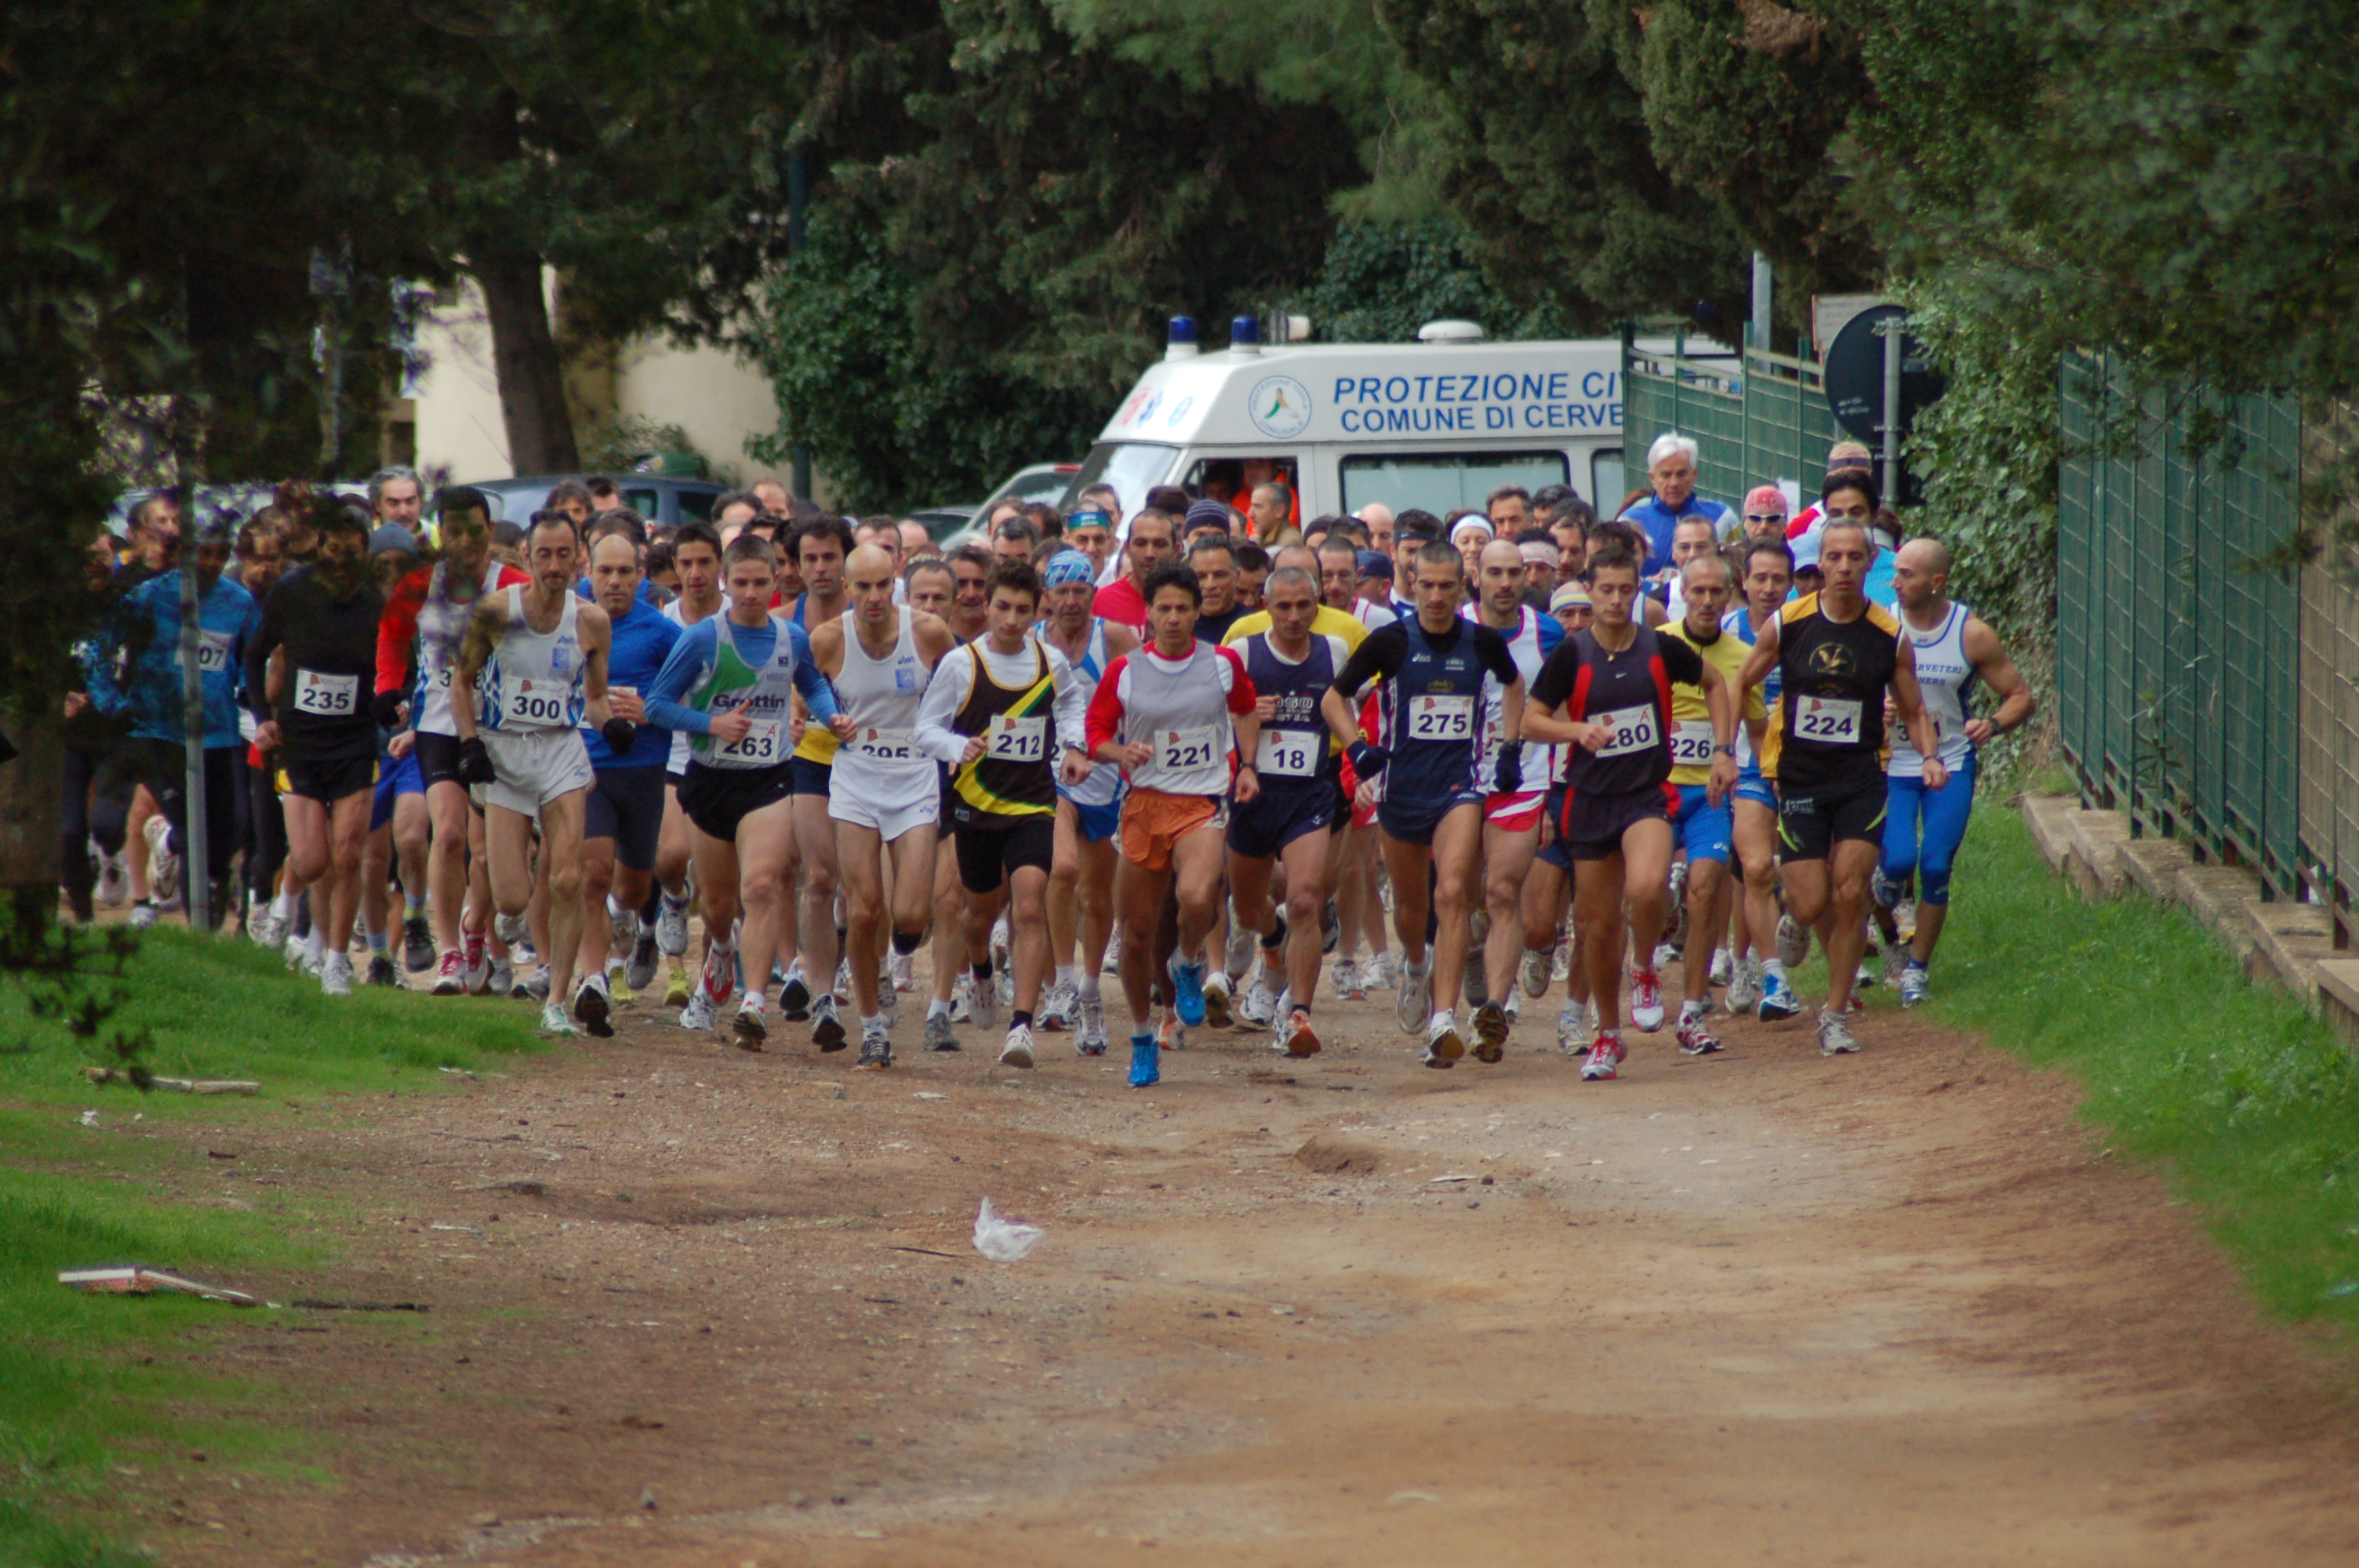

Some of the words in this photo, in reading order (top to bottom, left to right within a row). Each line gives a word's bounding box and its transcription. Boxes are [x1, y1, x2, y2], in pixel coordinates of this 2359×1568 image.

[1333, 373, 1569, 405] PROTEZIONE
[1341, 407, 1474, 432] COMUNE
[1485, 405, 1514, 430] DI
[1524, 403, 1623, 429] CERVE
[199, 646, 224, 666] 07
[1917, 663, 1962, 674] RVETERI
[1918, 677, 1946, 685] NERS
[303, 688, 349, 710] 235
[512, 695, 560, 720] 300
[1418, 714, 1467, 734] 275
[1802, 714, 1853, 736] 224
[1897, 720, 1942, 742] 31
[996, 734, 1040, 756] 212
[1165, 742, 1210, 767] 221
[1670, 738, 1710, 759] 226
[1273, 749, 1305, 770] 18
